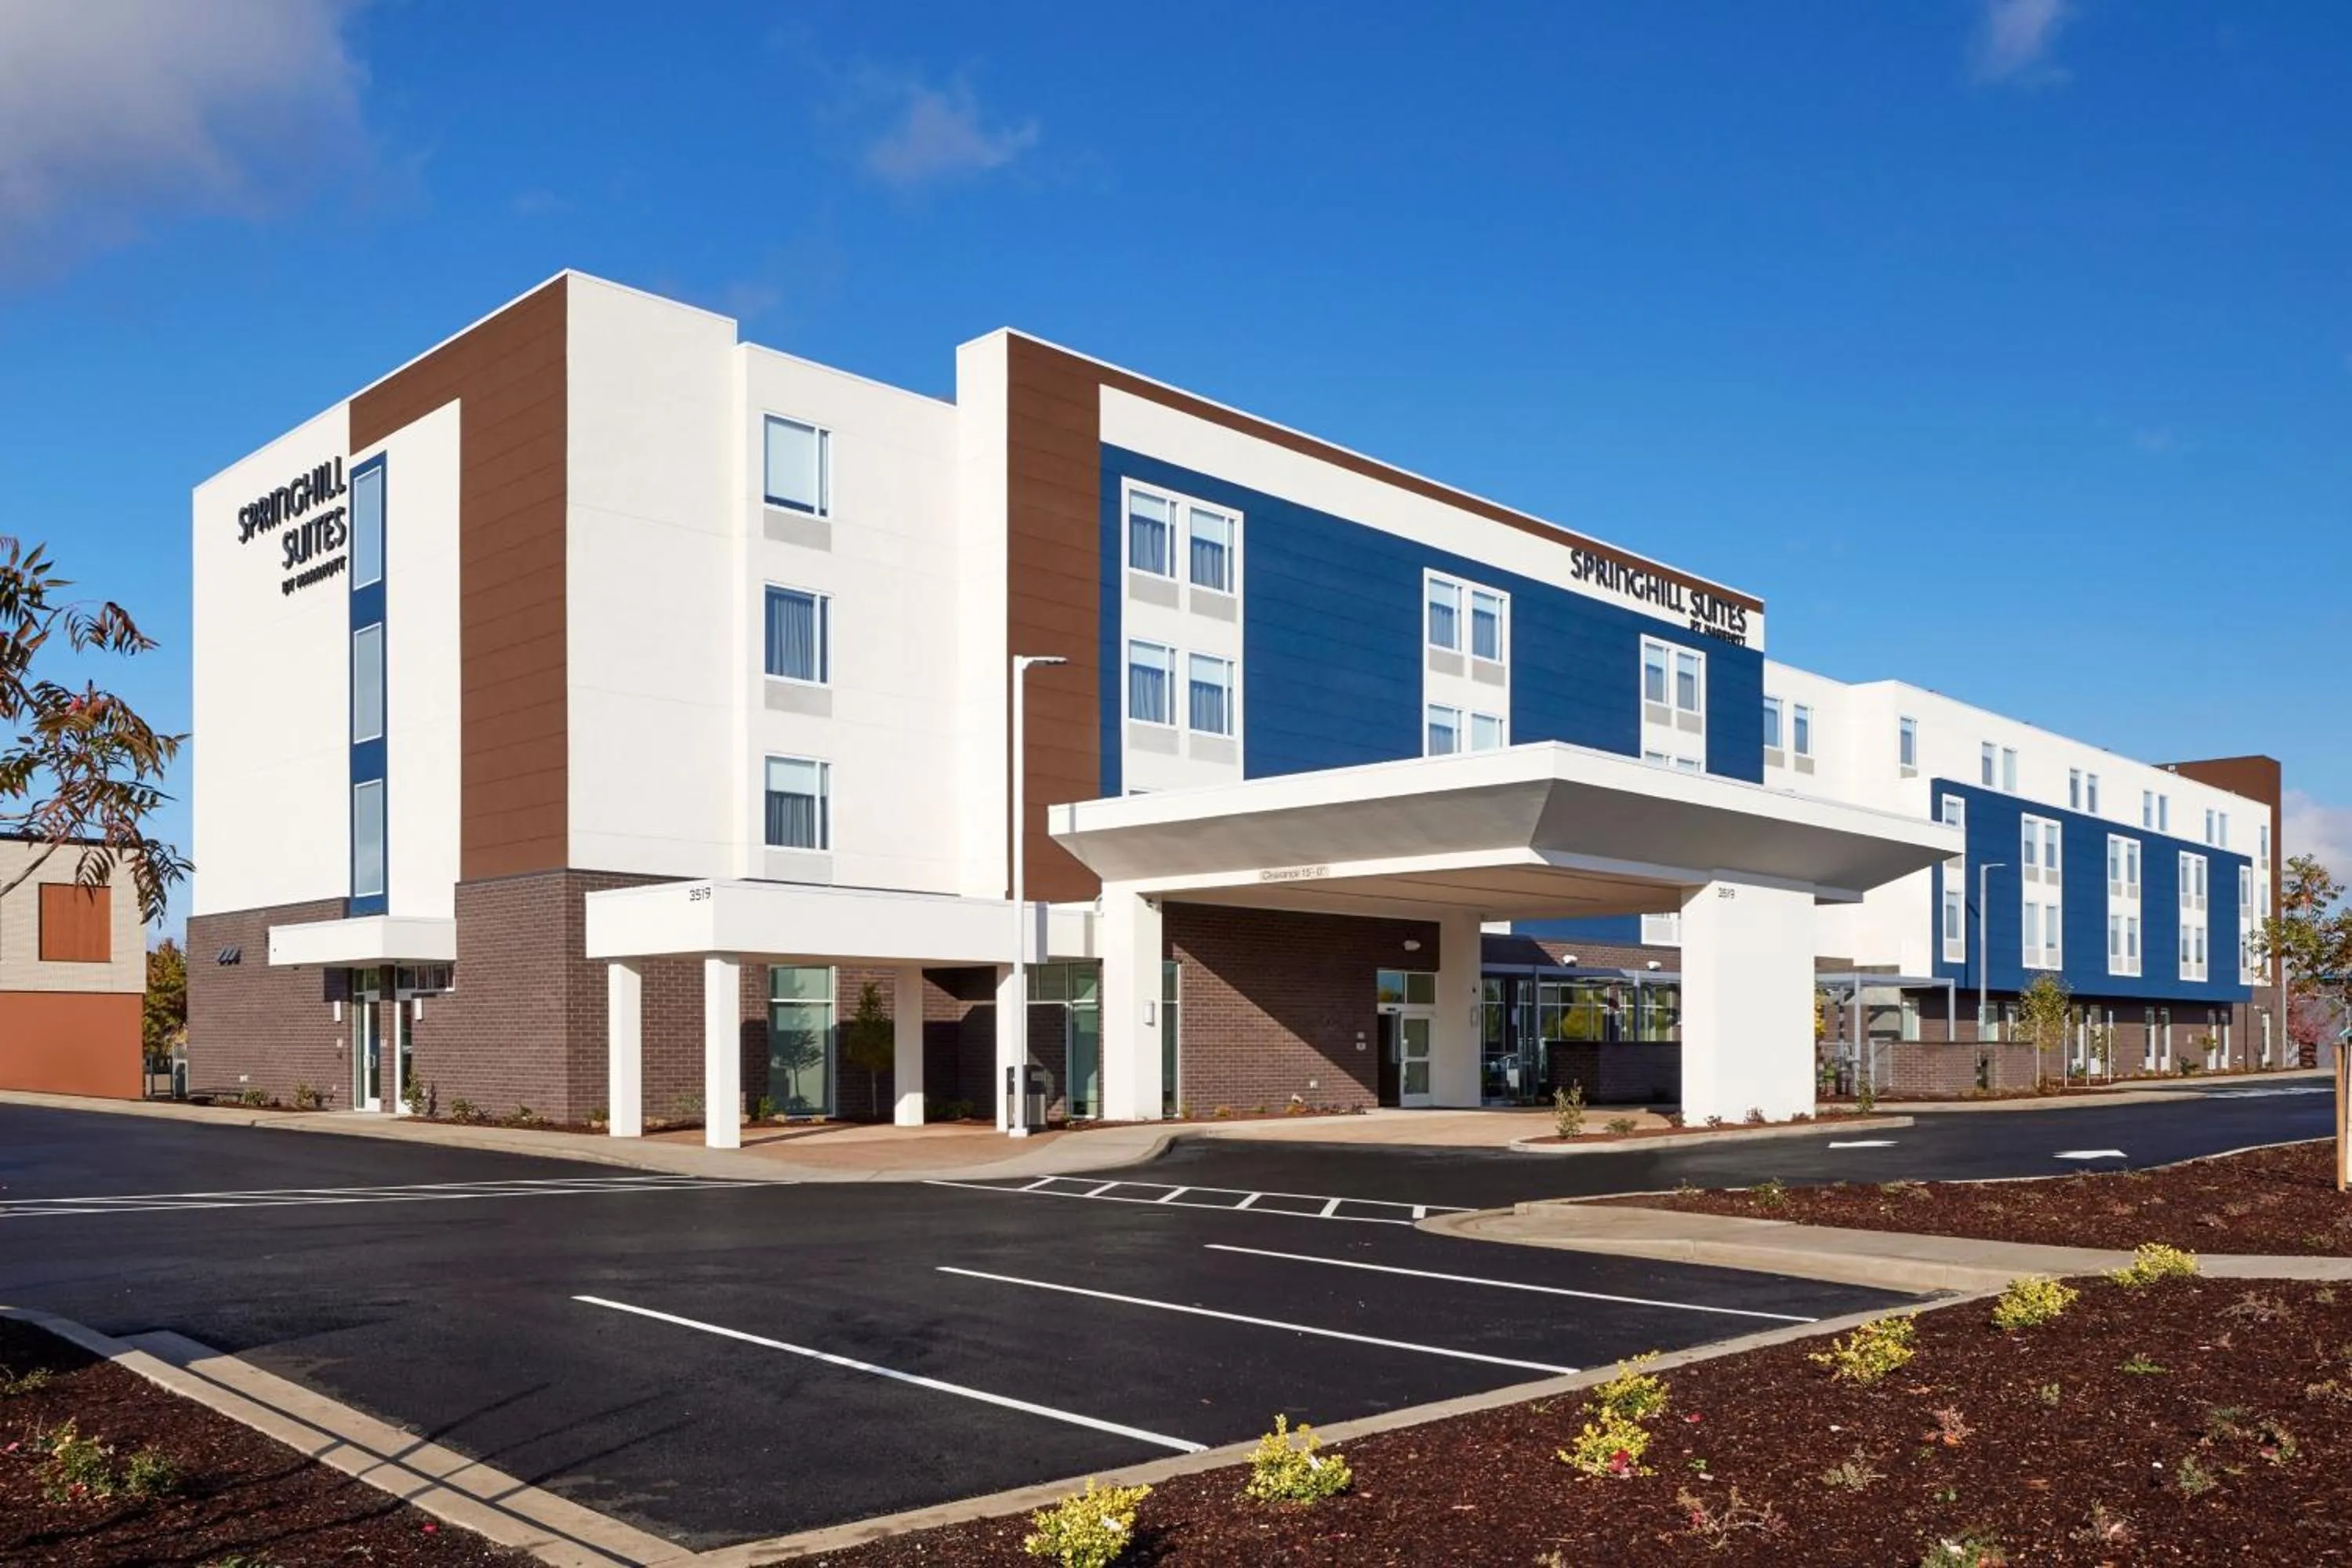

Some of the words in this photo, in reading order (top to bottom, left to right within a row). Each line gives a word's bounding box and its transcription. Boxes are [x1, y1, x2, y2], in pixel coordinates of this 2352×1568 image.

[238, 456, 347, 544] SPRINGHILL
[282, 506, 347, 569] SUITES
[1570, 549, 1686, 615] SPRINGHILL
[1690, 590, 1747, 633] SUITES
[690, 887, 711, 901] 3519
